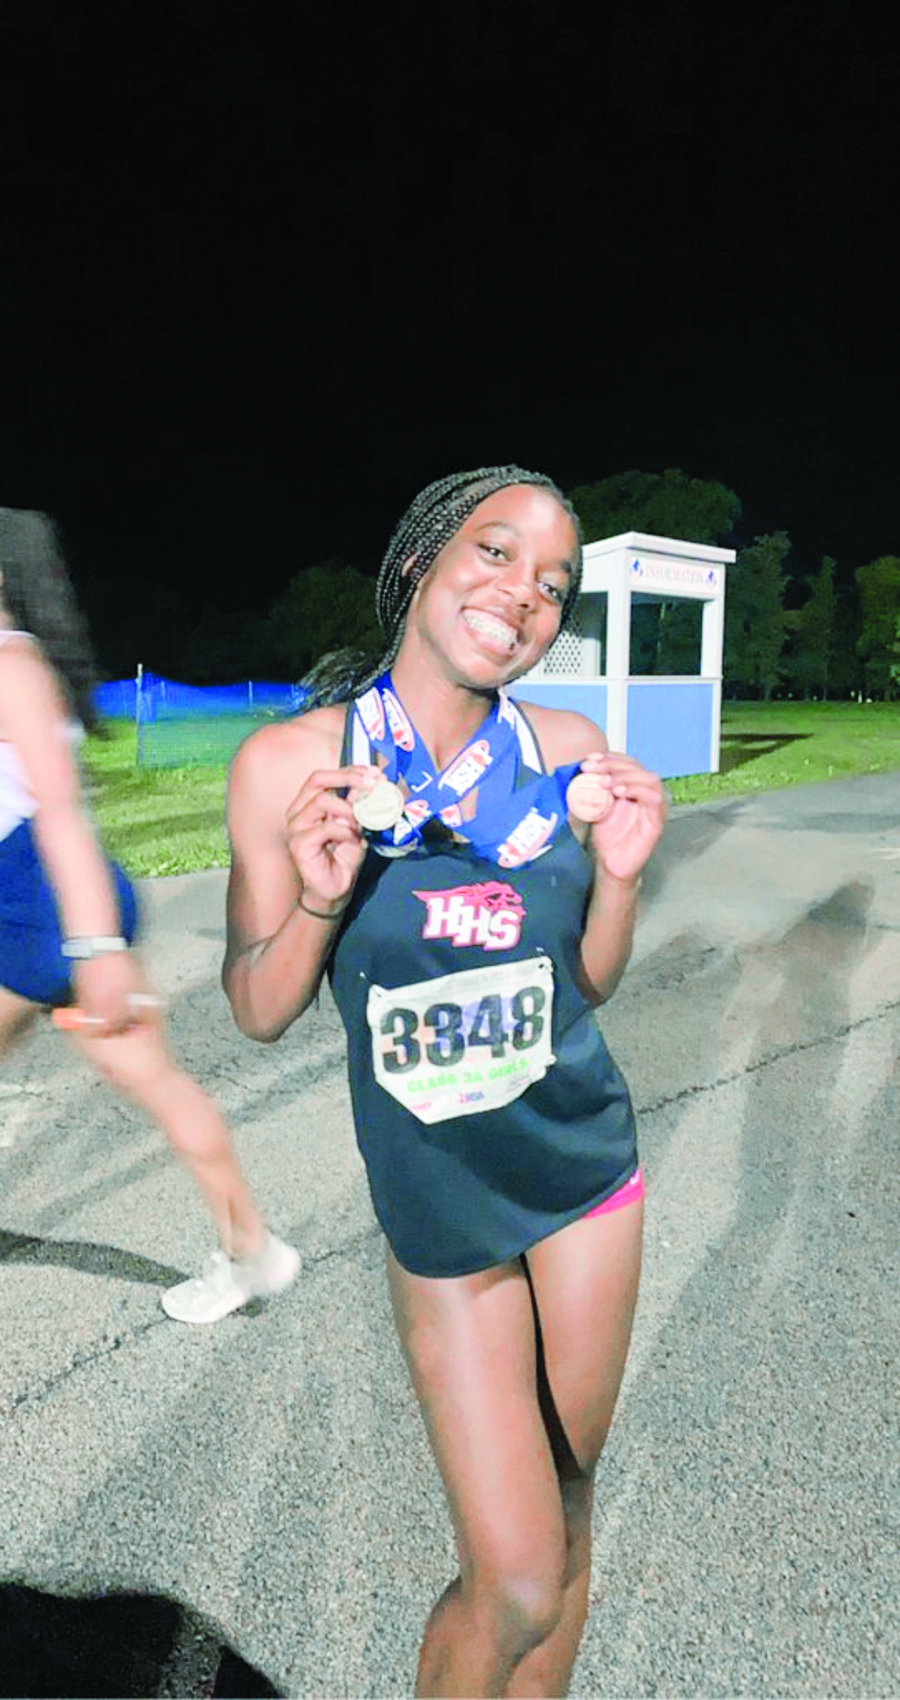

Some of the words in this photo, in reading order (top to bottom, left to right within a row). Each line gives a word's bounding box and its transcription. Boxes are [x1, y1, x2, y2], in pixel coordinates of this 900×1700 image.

[423, 896, 522, 951] HHS
[380, 986, 546, 1074] 3348
[407, 1073, 458, 1093] CLASS
[463, 1070, 483, 1084] 3A
[488, 1059, 529, 1080] GIRLS
